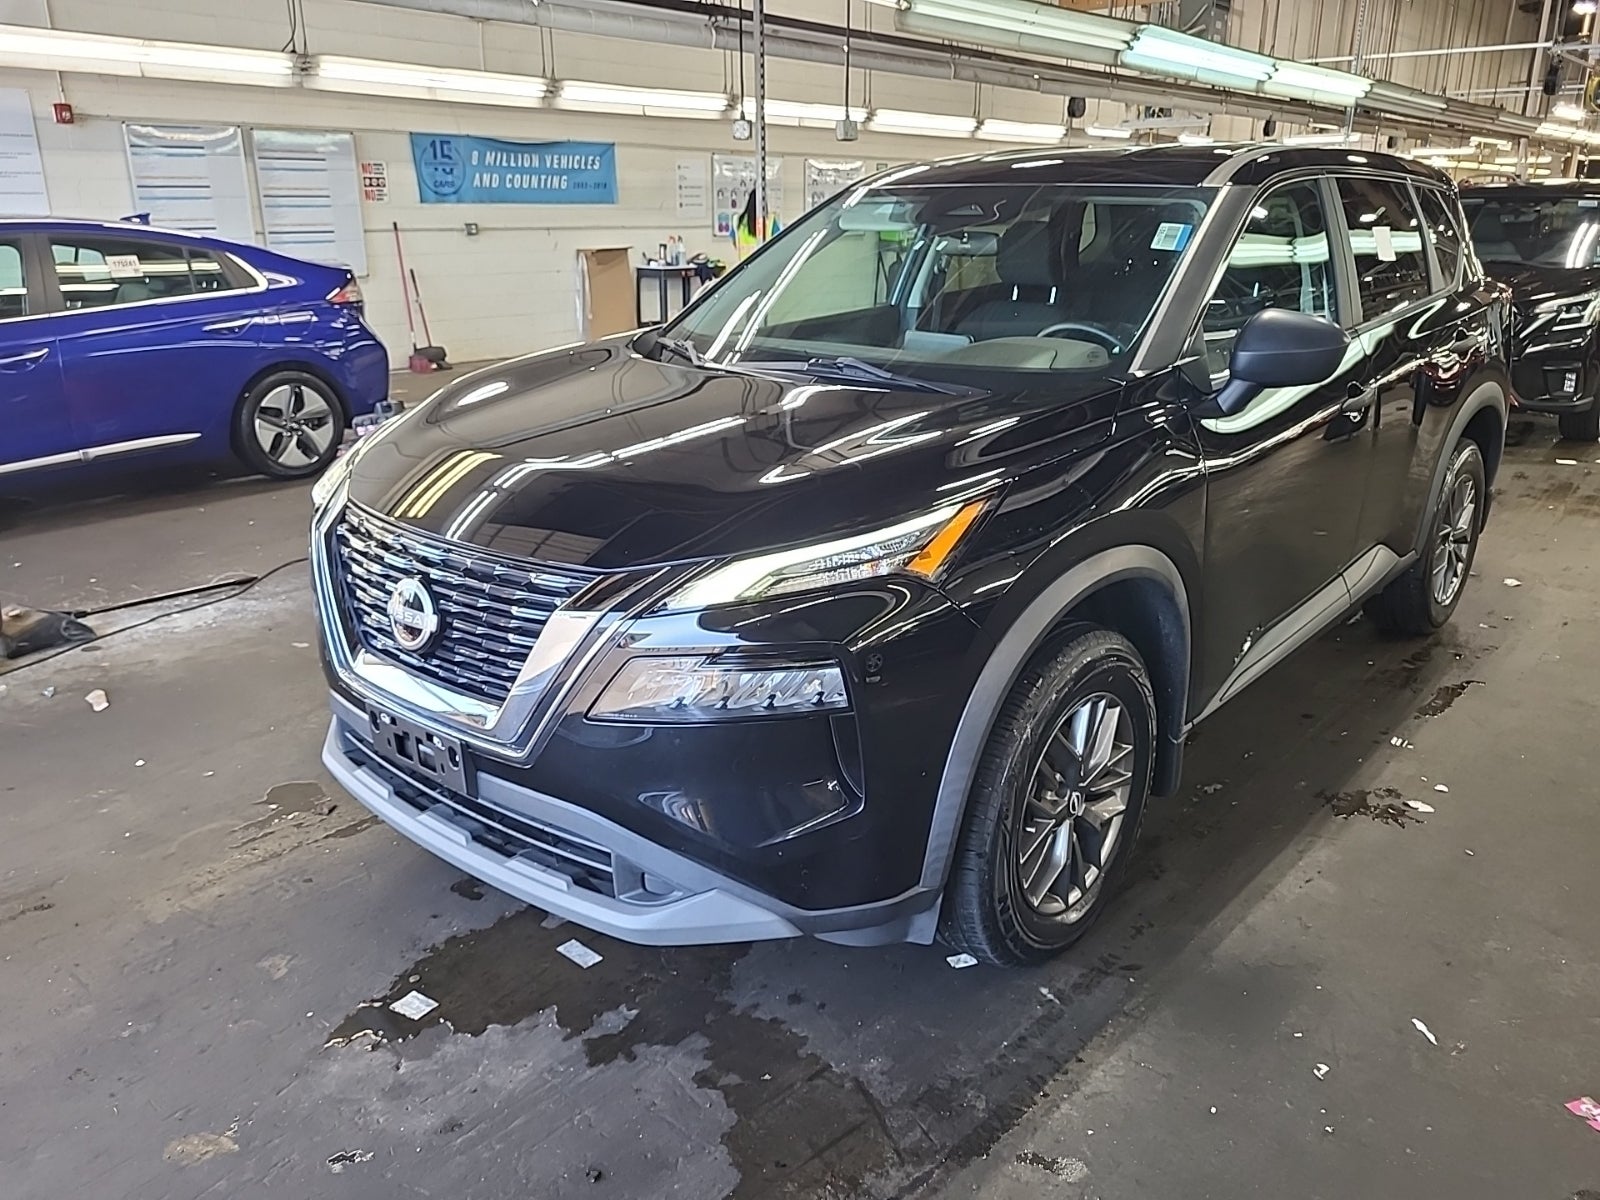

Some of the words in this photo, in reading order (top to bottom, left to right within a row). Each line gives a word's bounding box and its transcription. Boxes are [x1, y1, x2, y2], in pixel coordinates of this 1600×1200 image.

[430, 139, 453, 161] 15
[485, 151, 540, 168] MILLION
[545, 154, 601, 170] VEHICLES
[473, 172, 500, 189] AND
[505, 173, 568, 190] COUNTING
